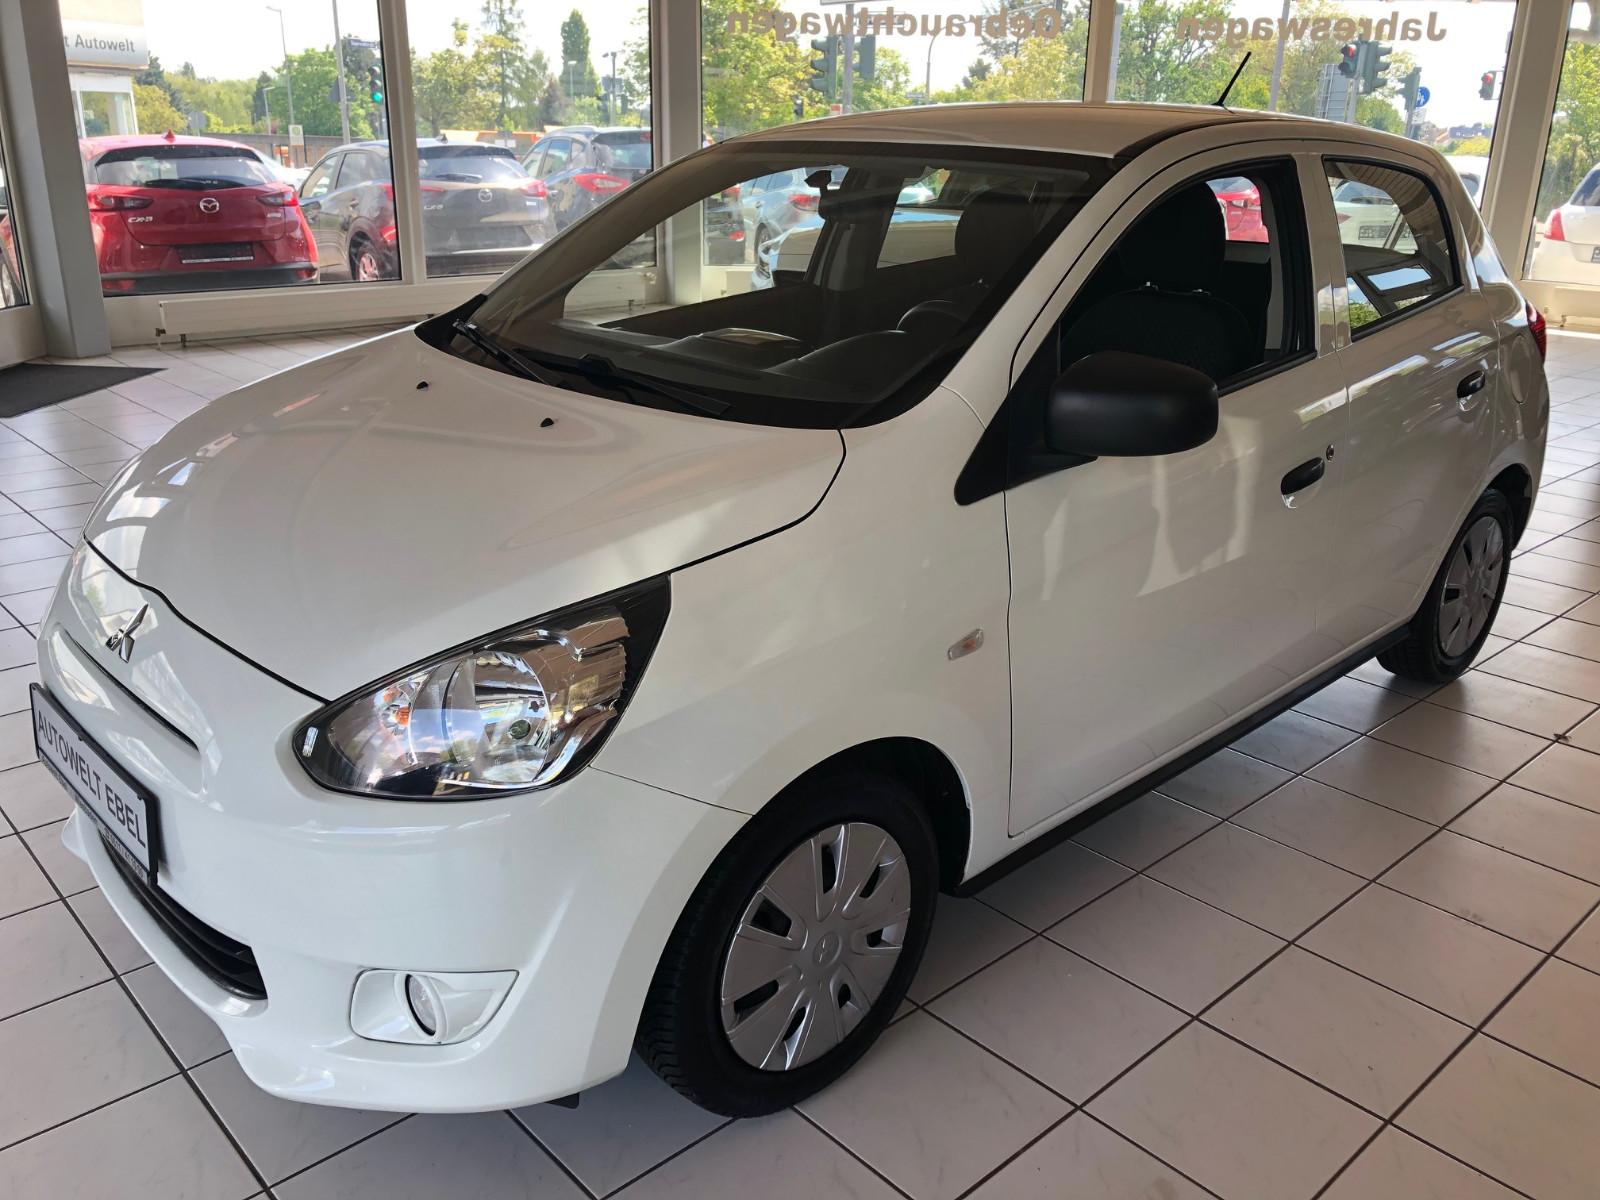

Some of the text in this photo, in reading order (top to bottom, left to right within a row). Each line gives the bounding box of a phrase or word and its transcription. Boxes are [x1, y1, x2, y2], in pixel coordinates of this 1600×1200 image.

[75, 33, 135, 53] Autowelt
[38, 710, 102, 801] AUTOWELT
[104, 783, 146, 849] EBEL
